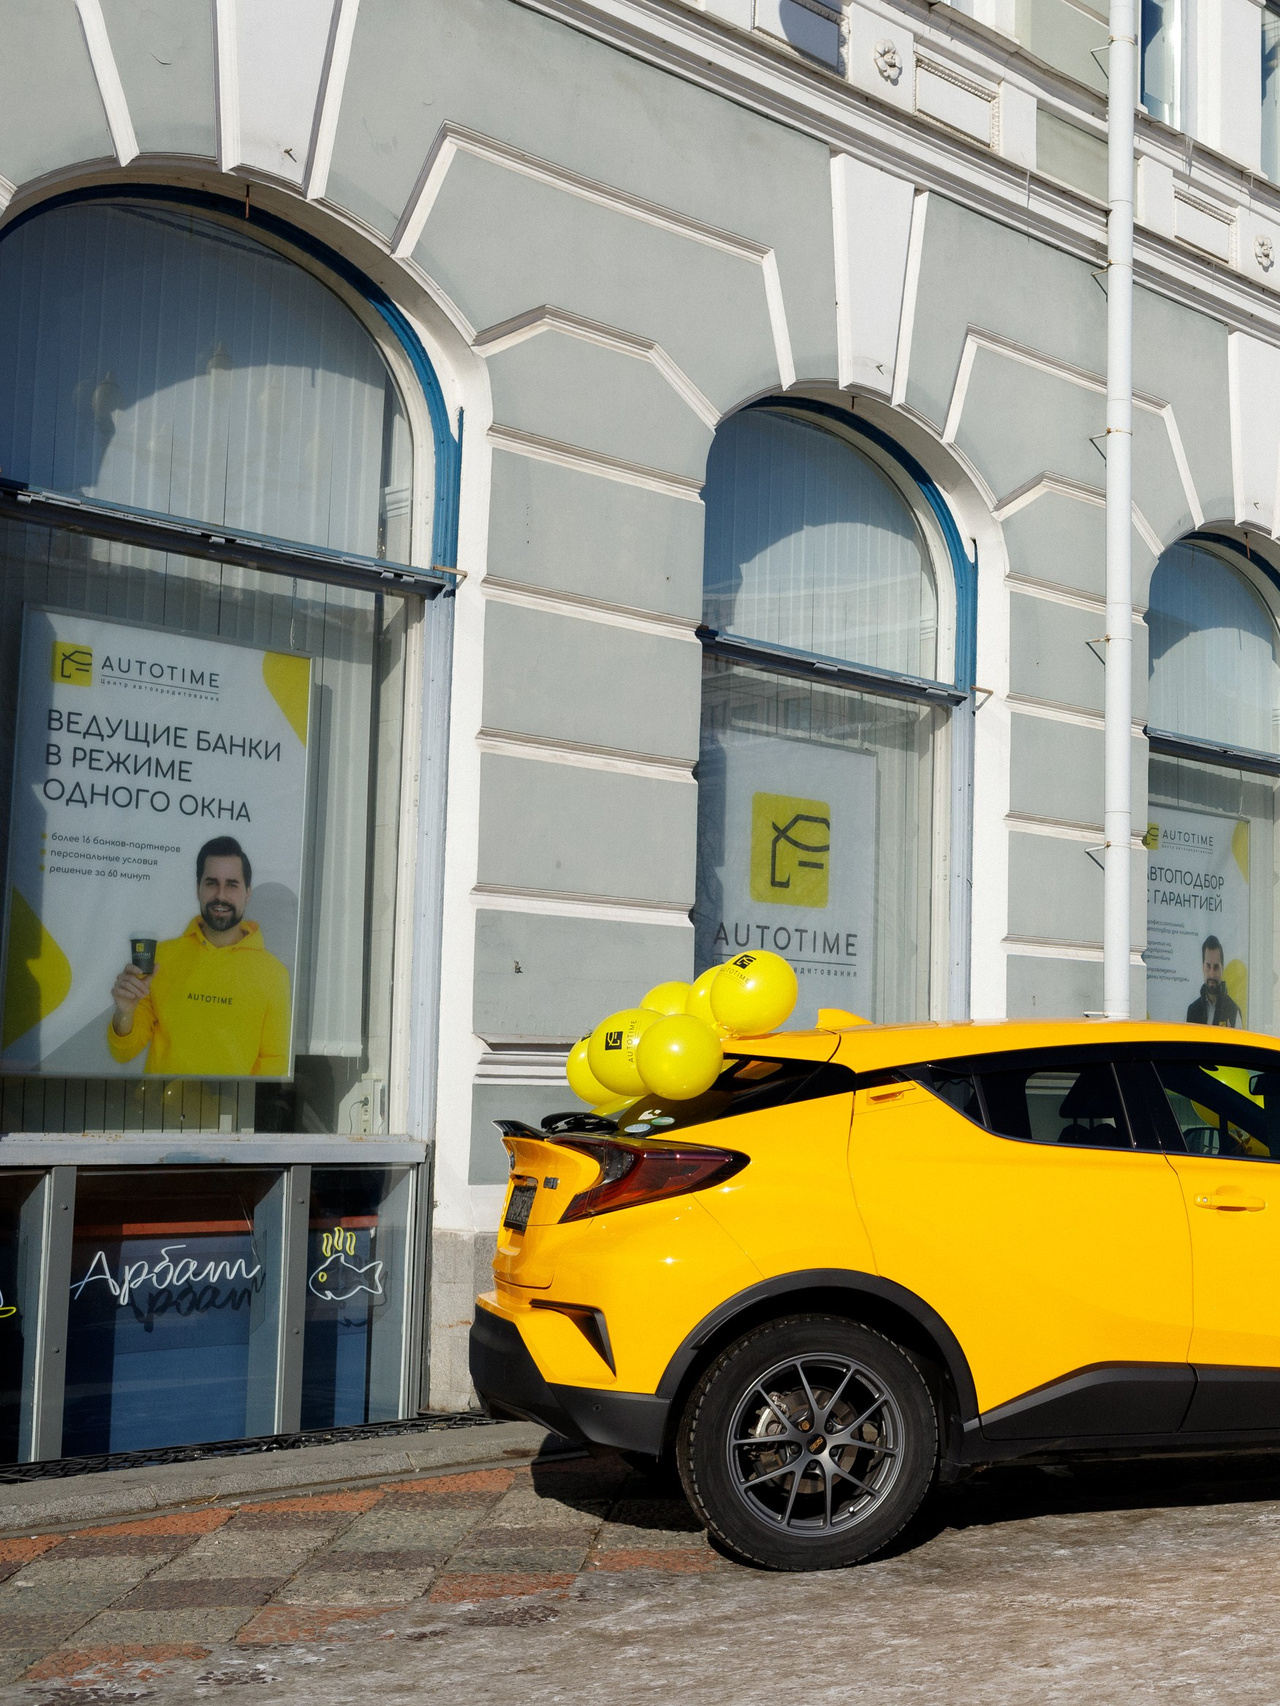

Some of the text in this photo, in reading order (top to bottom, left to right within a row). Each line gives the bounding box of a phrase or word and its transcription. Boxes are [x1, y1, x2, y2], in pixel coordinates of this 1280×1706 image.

[100, 678, 128, 688] Центр
[101, 655, 220, 688] AUTOTIME
[48, 708, 281, 762] ВЕДУЩИЕ БАНКИ
[45, 744, 193, 783] В РЕЖИМЕ
[42, 778, 251, 823] ОДНОГО ОКНА
[51, 832, 181, 853] более 16 банков-партнеров
[1162, 829, 1214, 847] AUTOTIME
[50, 849, 158, 866] персональные условия
[49, 865, 151, 881] решение за 60 минут
[1147, 866, 1225, 890] ВТОПОДБОР
[1153, 889, 1223, 912] ГАРАНТИЕЙ
[714, 921, 858, 957] AUTOTIME
[793, 966, 858, 978] едитования
[187, 993, 233, 1005] AUTOTIME
[627, 1020, 638, 1063] AUTOTIME
[69, 1244, 261, 1305] Арбат
